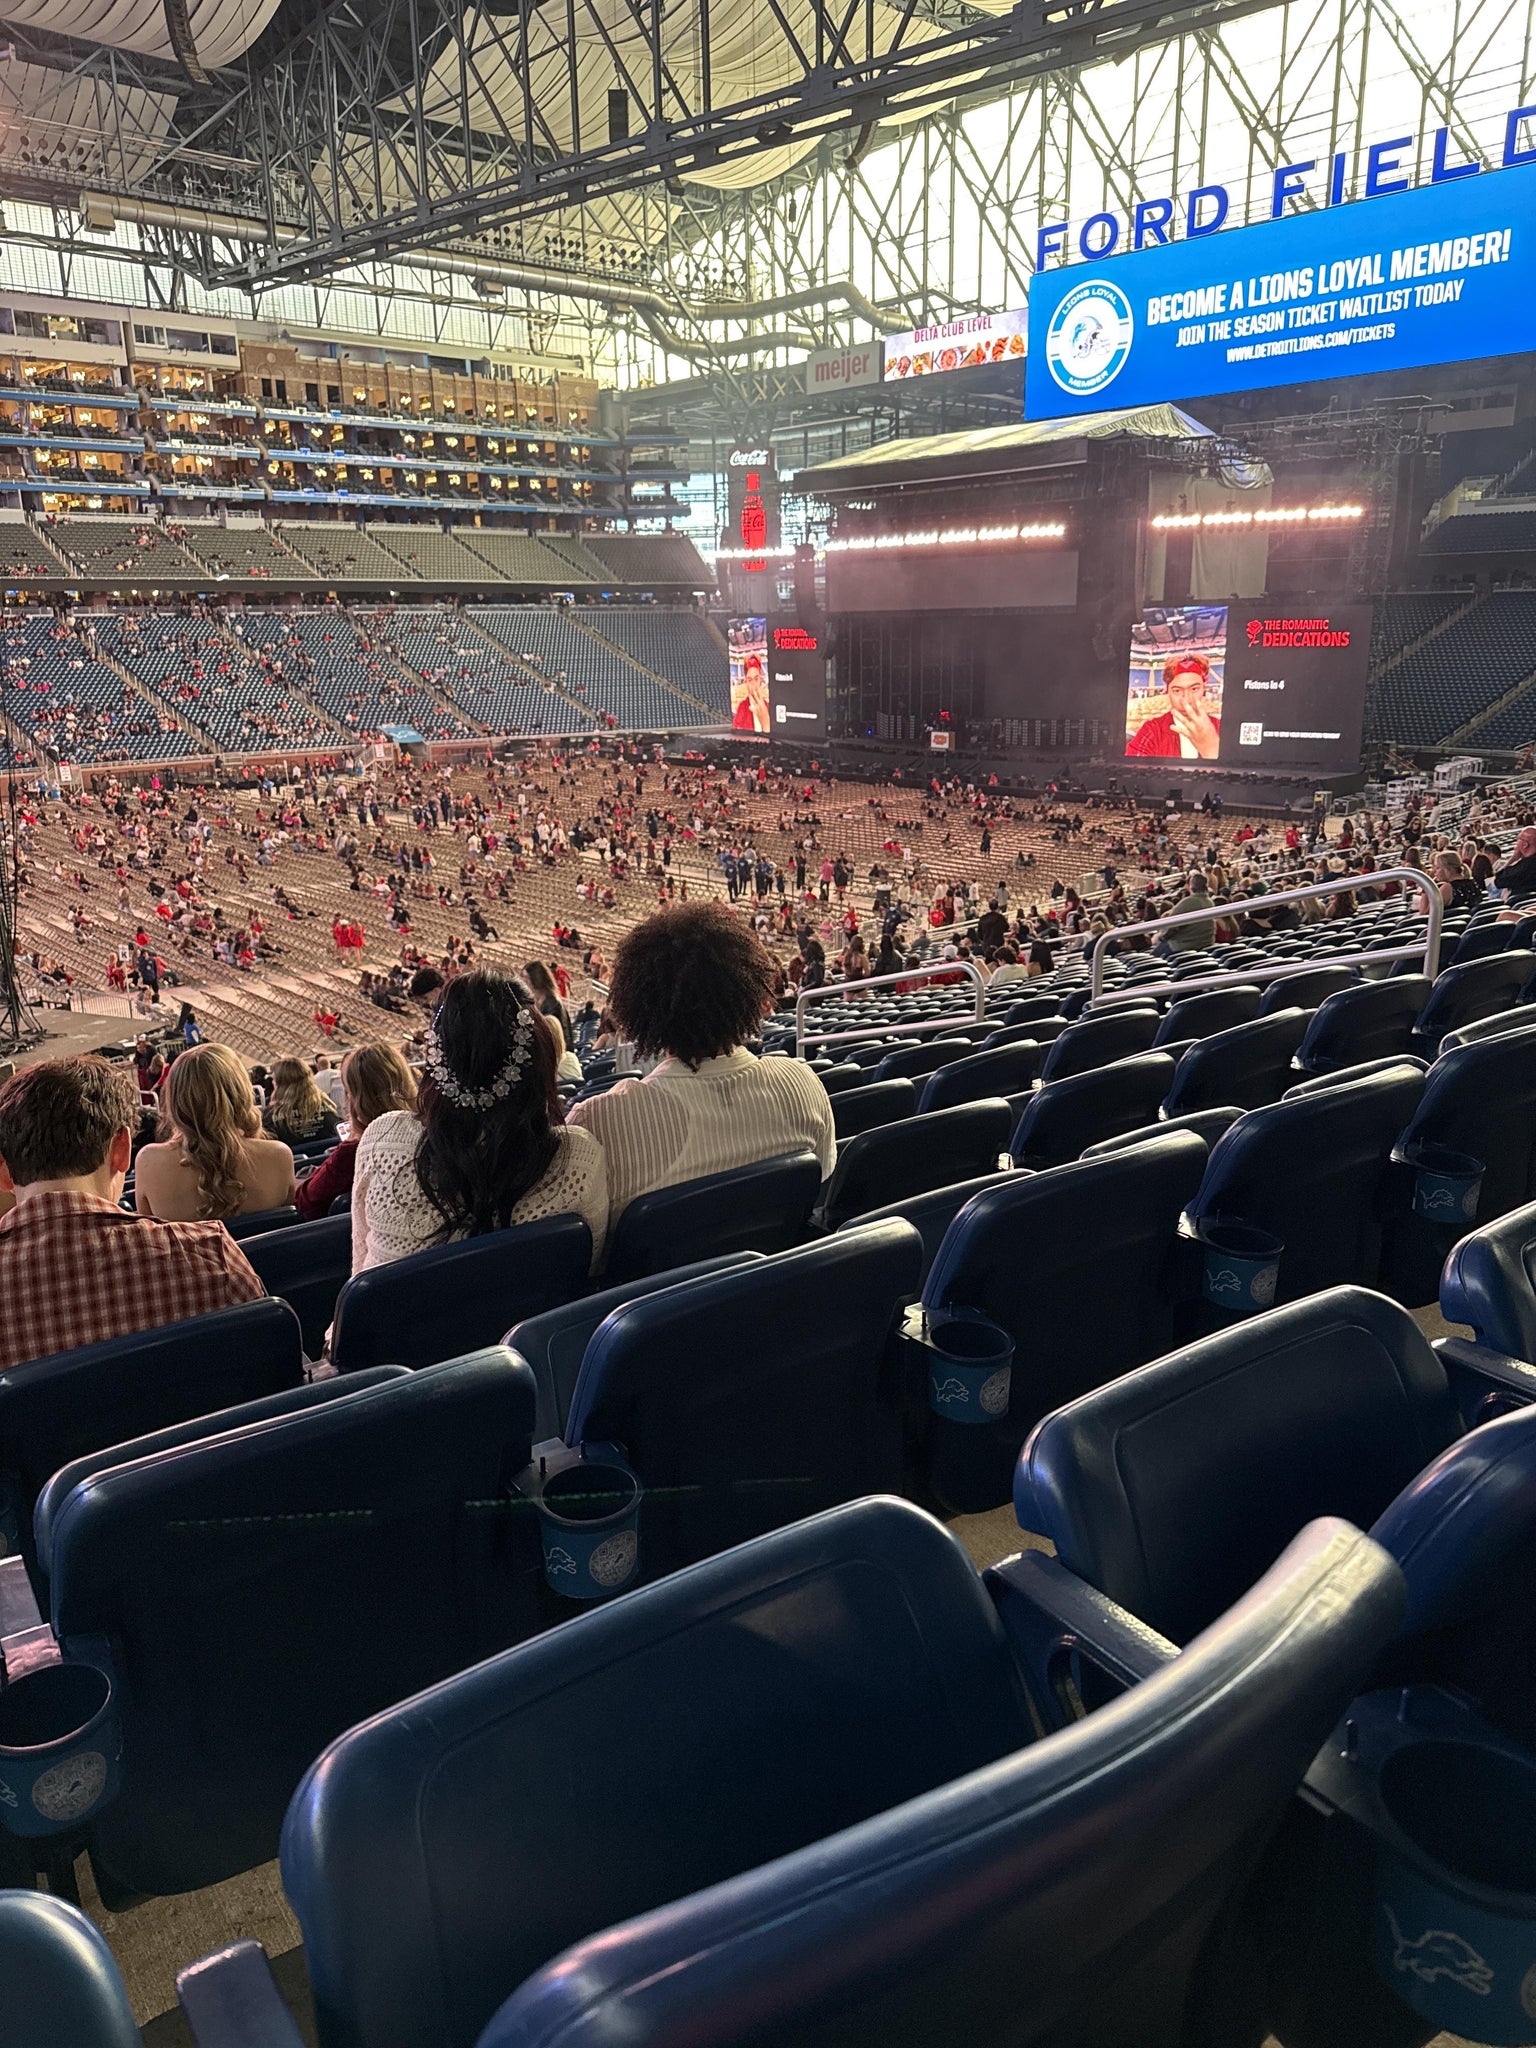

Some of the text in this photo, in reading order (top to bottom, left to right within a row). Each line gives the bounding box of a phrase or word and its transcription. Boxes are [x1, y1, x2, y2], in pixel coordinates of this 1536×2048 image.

[1034, 184, 1230, 273] FORD
[1147, 228, 1512, 326] BECOME A LIONS LOYAL MEMBER!
[1061, 288, 1117, 315] LIONS LOYAL
[1176, 279, 1465, 347] JOIN THE SEASON TICKET WAITLIST TODAY
[914, 316, 993, 343] DELTA CLUB LEVEL
[1227, 323, 1396, 363] WWW.DETROITLIONS.COM/TICKETS
[815, 350, 871, 384] meijer
[1068, 370, 1109, 388] MEMBER
[729, 449, 769, 467] Coca-Cola
[1264, 619, 1330, 630] THE ROMANTIC
[1262, 631, 1351, 647] DEDICATIONS
